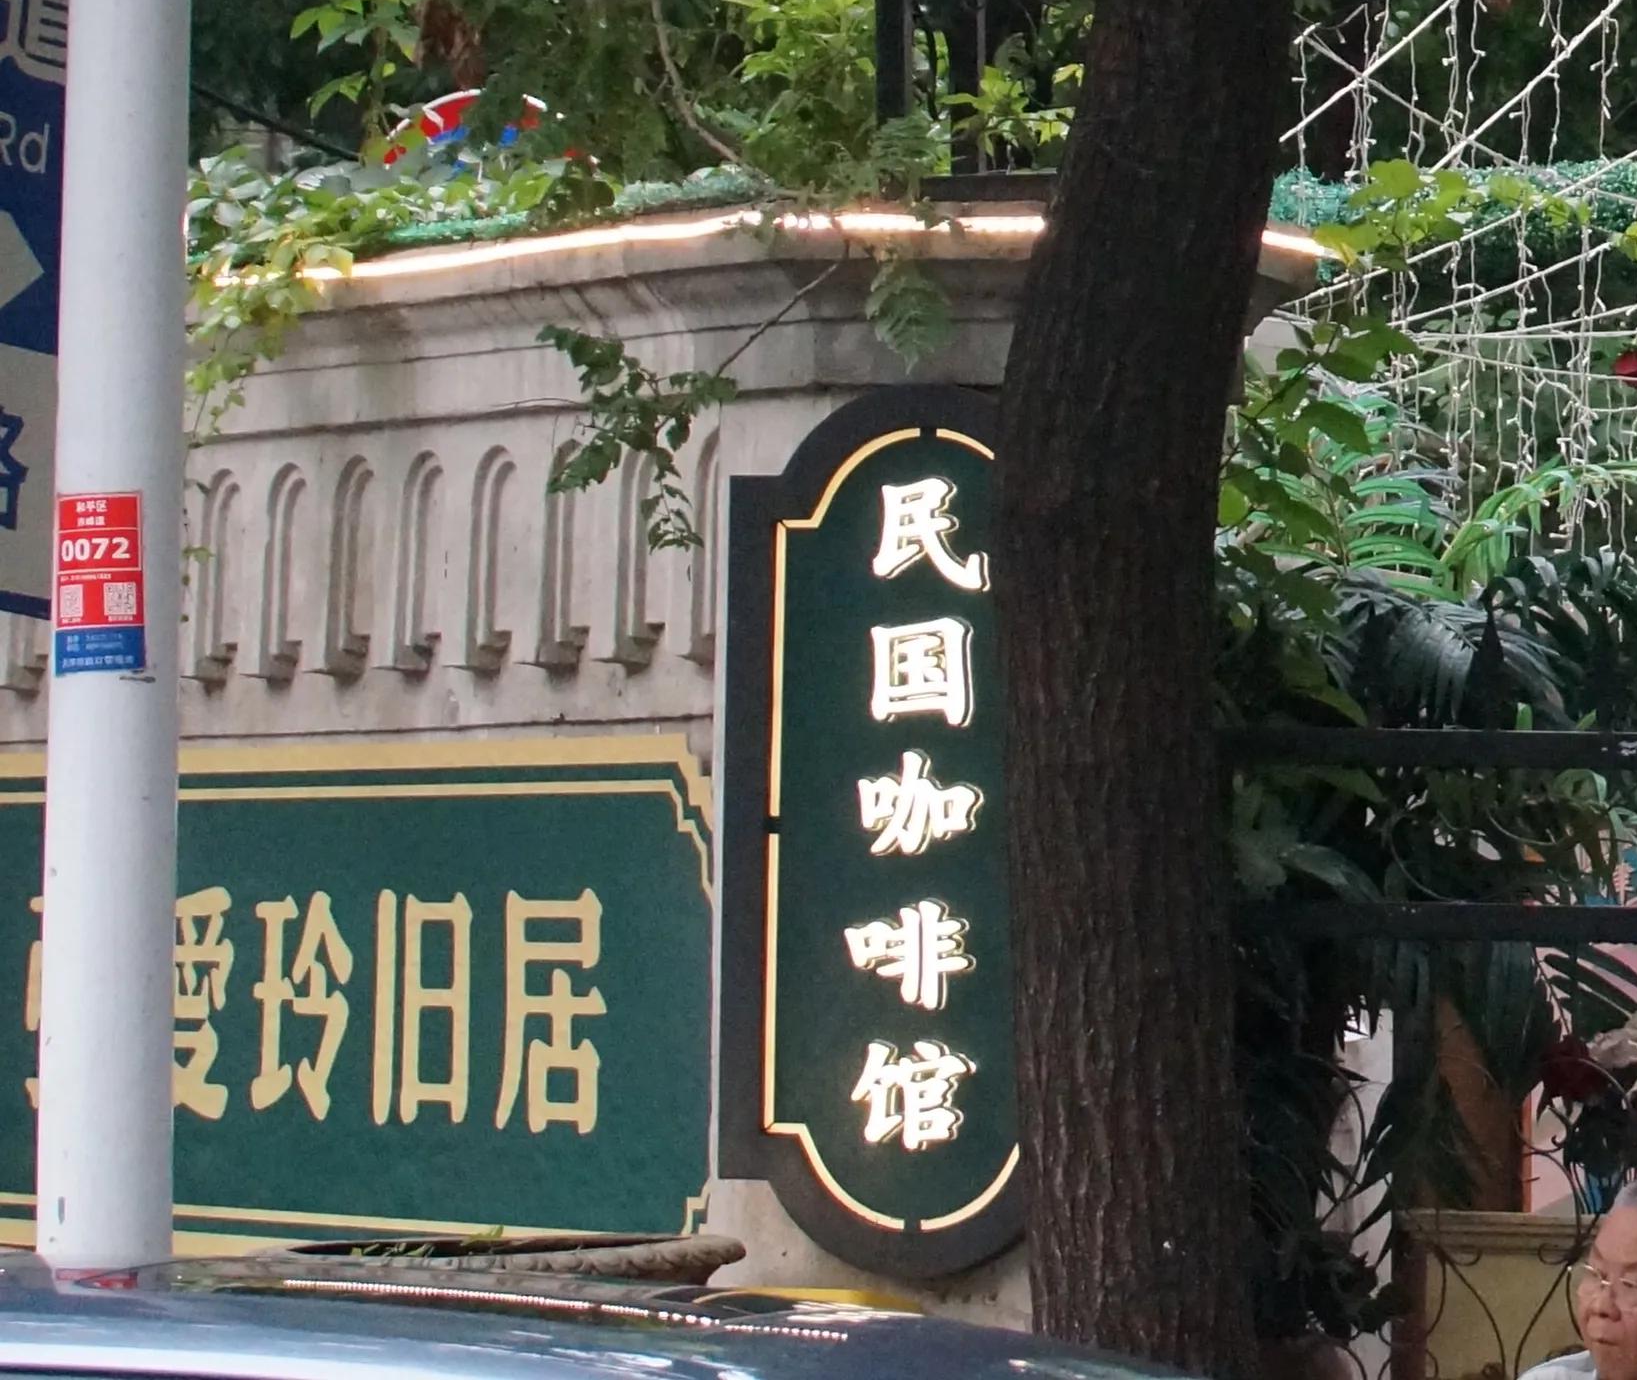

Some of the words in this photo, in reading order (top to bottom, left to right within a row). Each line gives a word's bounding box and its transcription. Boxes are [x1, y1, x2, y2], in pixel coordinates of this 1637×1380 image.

[0, 111, 49, 174] Rd
[61, 536, 131, 562] 0072
[843, 476, 990, 1151] 民国咖啡馆
[25, 884, 607, 1134] 愛玲旧居
